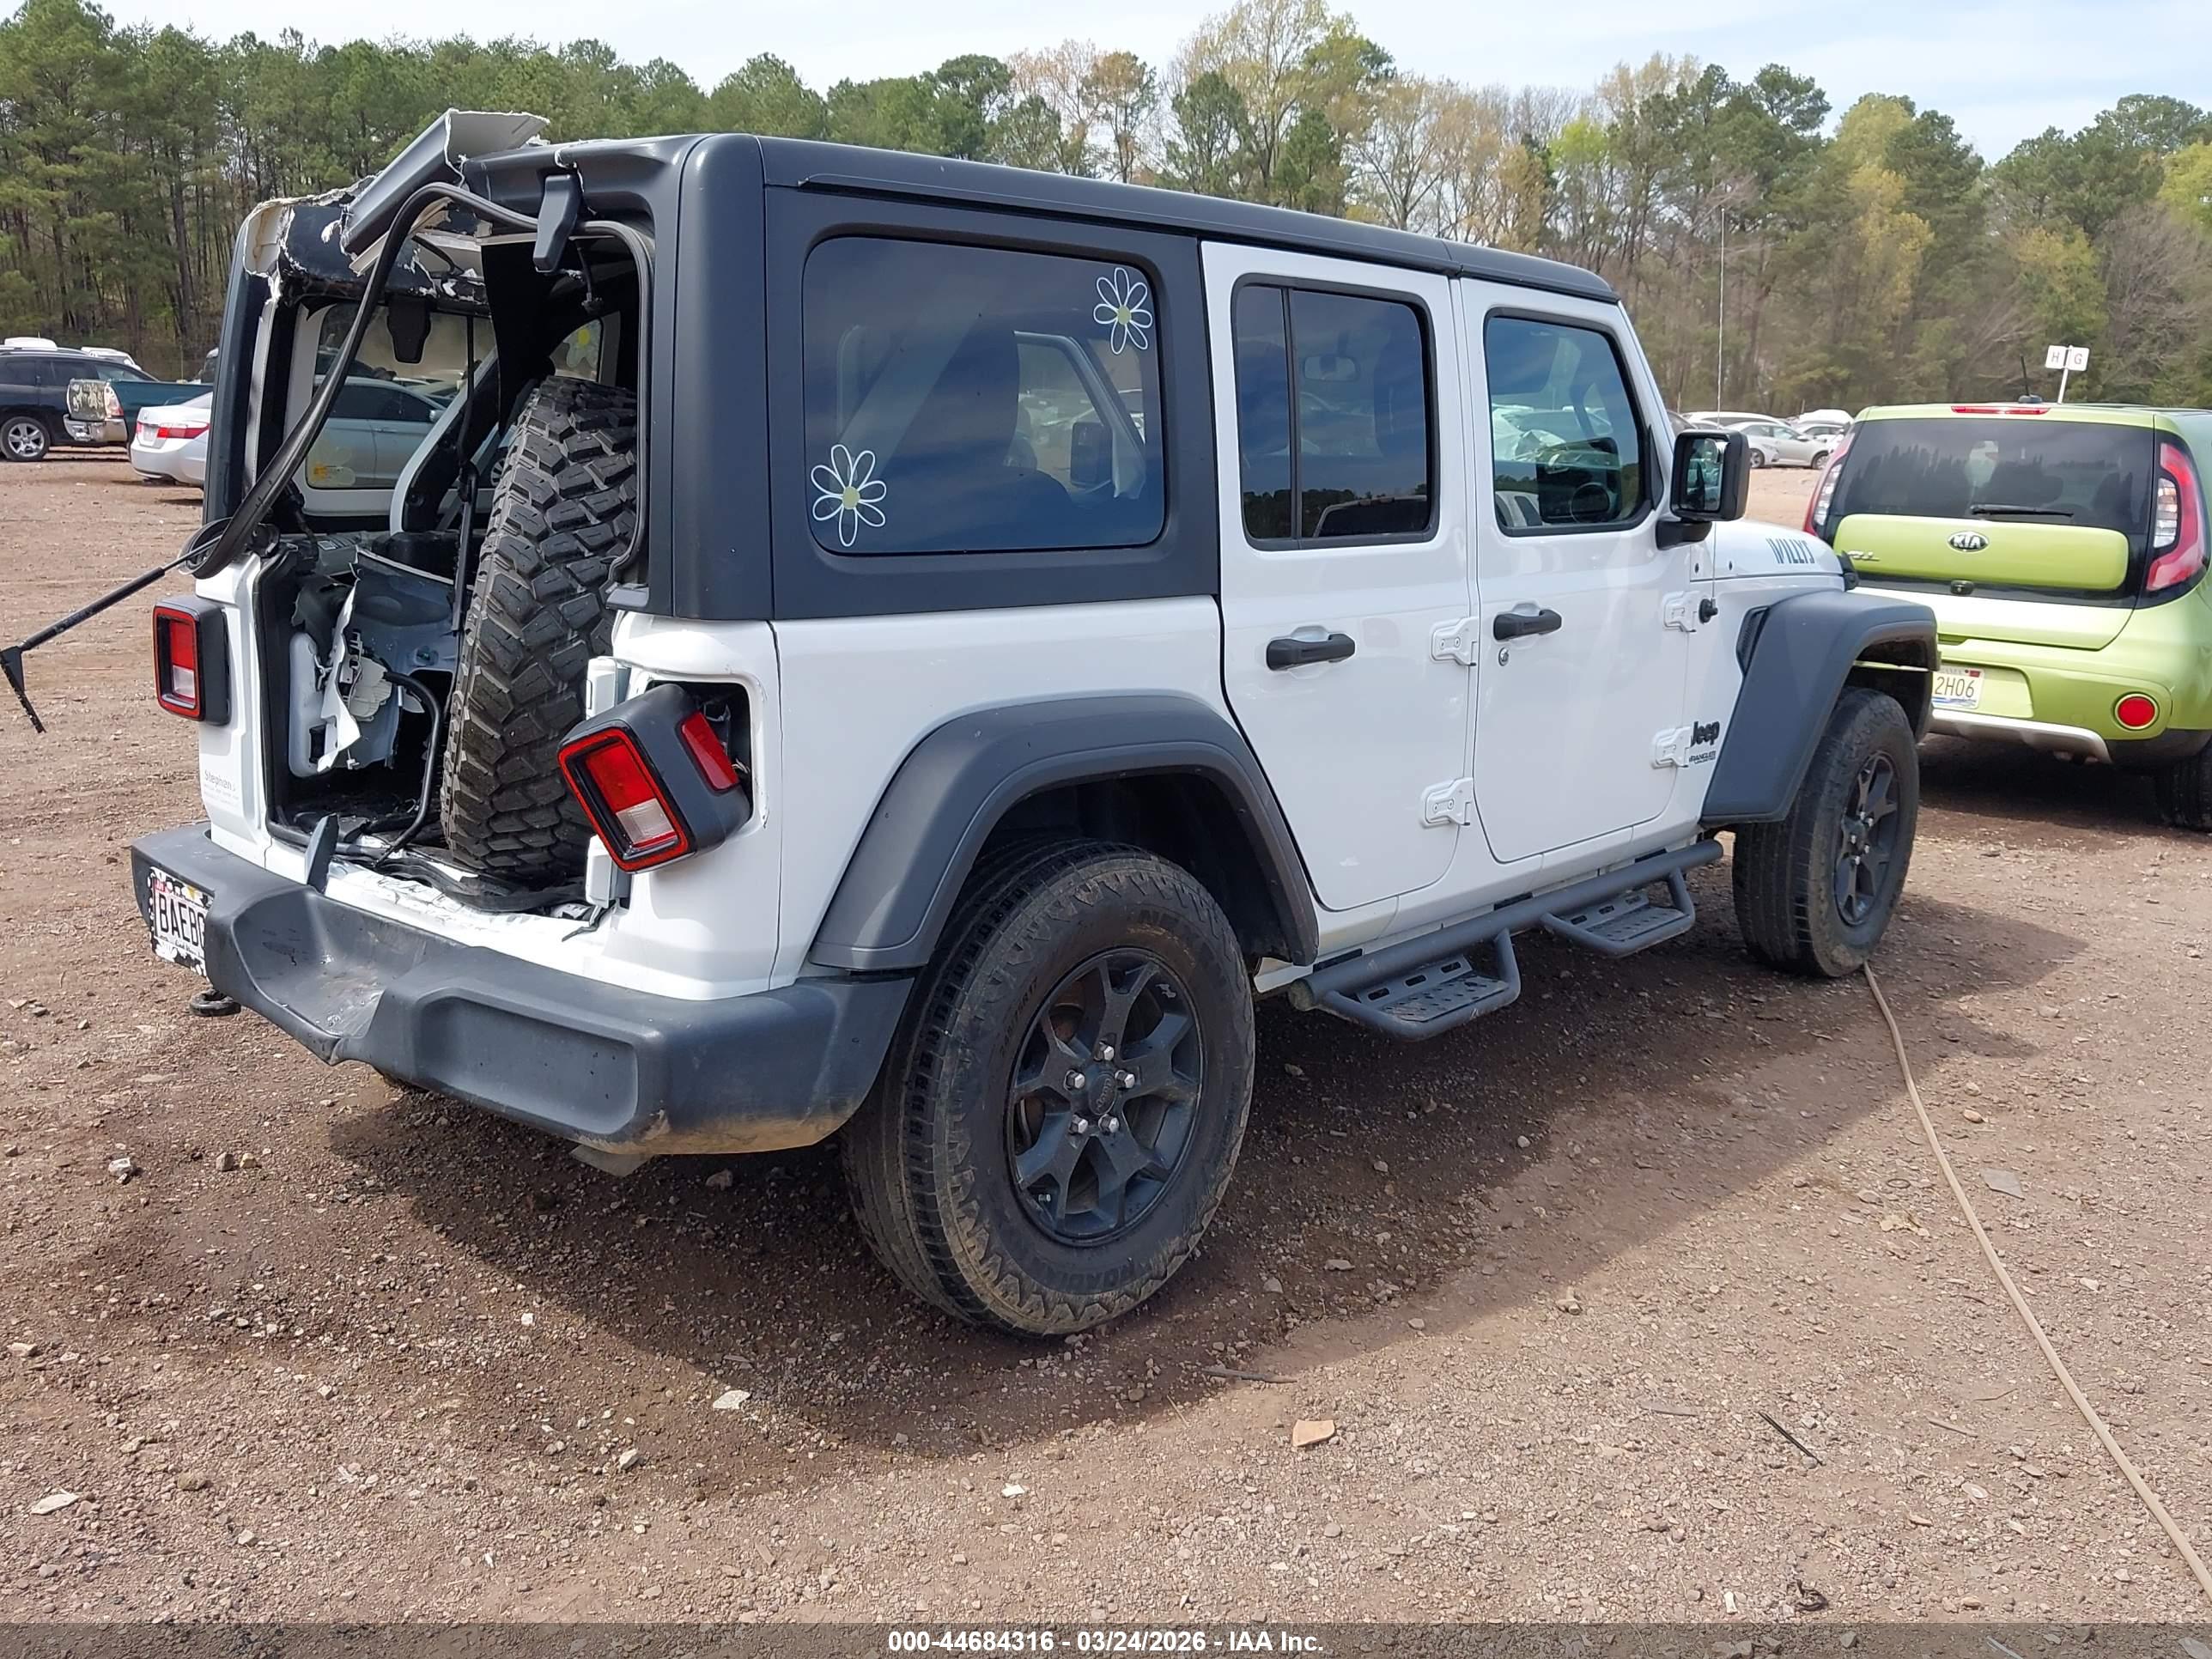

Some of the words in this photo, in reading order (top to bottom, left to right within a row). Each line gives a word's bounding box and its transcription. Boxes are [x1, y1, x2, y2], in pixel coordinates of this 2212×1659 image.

[2051, 351, 2060, 363] H
[2074, 353, 2083, 365] G
[1953, 534, 1981, 549] KIA
[1935, 676, 1975, 698] 2H06
[1690, 720, 1720, 747] Jeep
